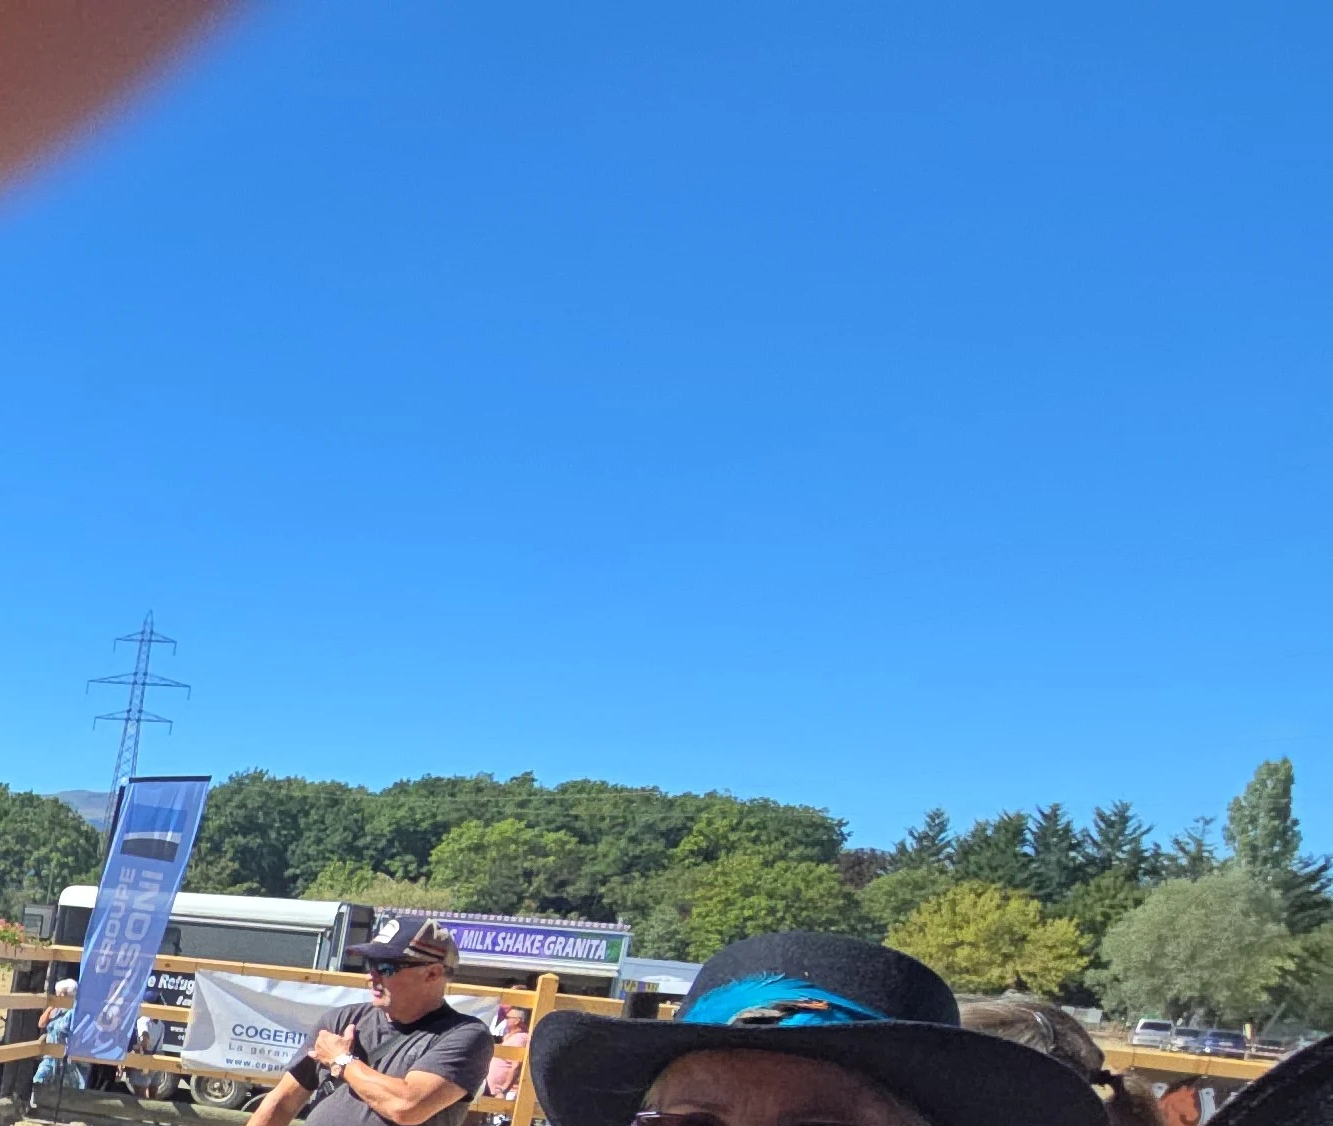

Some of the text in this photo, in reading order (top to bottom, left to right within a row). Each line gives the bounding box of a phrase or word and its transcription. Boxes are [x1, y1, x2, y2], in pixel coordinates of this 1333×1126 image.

[94, 866, 137, 975] GROUPE
[459, 929, 496, 951] MILK
[494, 931, 544, 955] SHAKE
[543, 935, 607, 960] GRANITA
[158, 973, 195, 995] Refug
[229, 1042, 296, 1058] La géran
